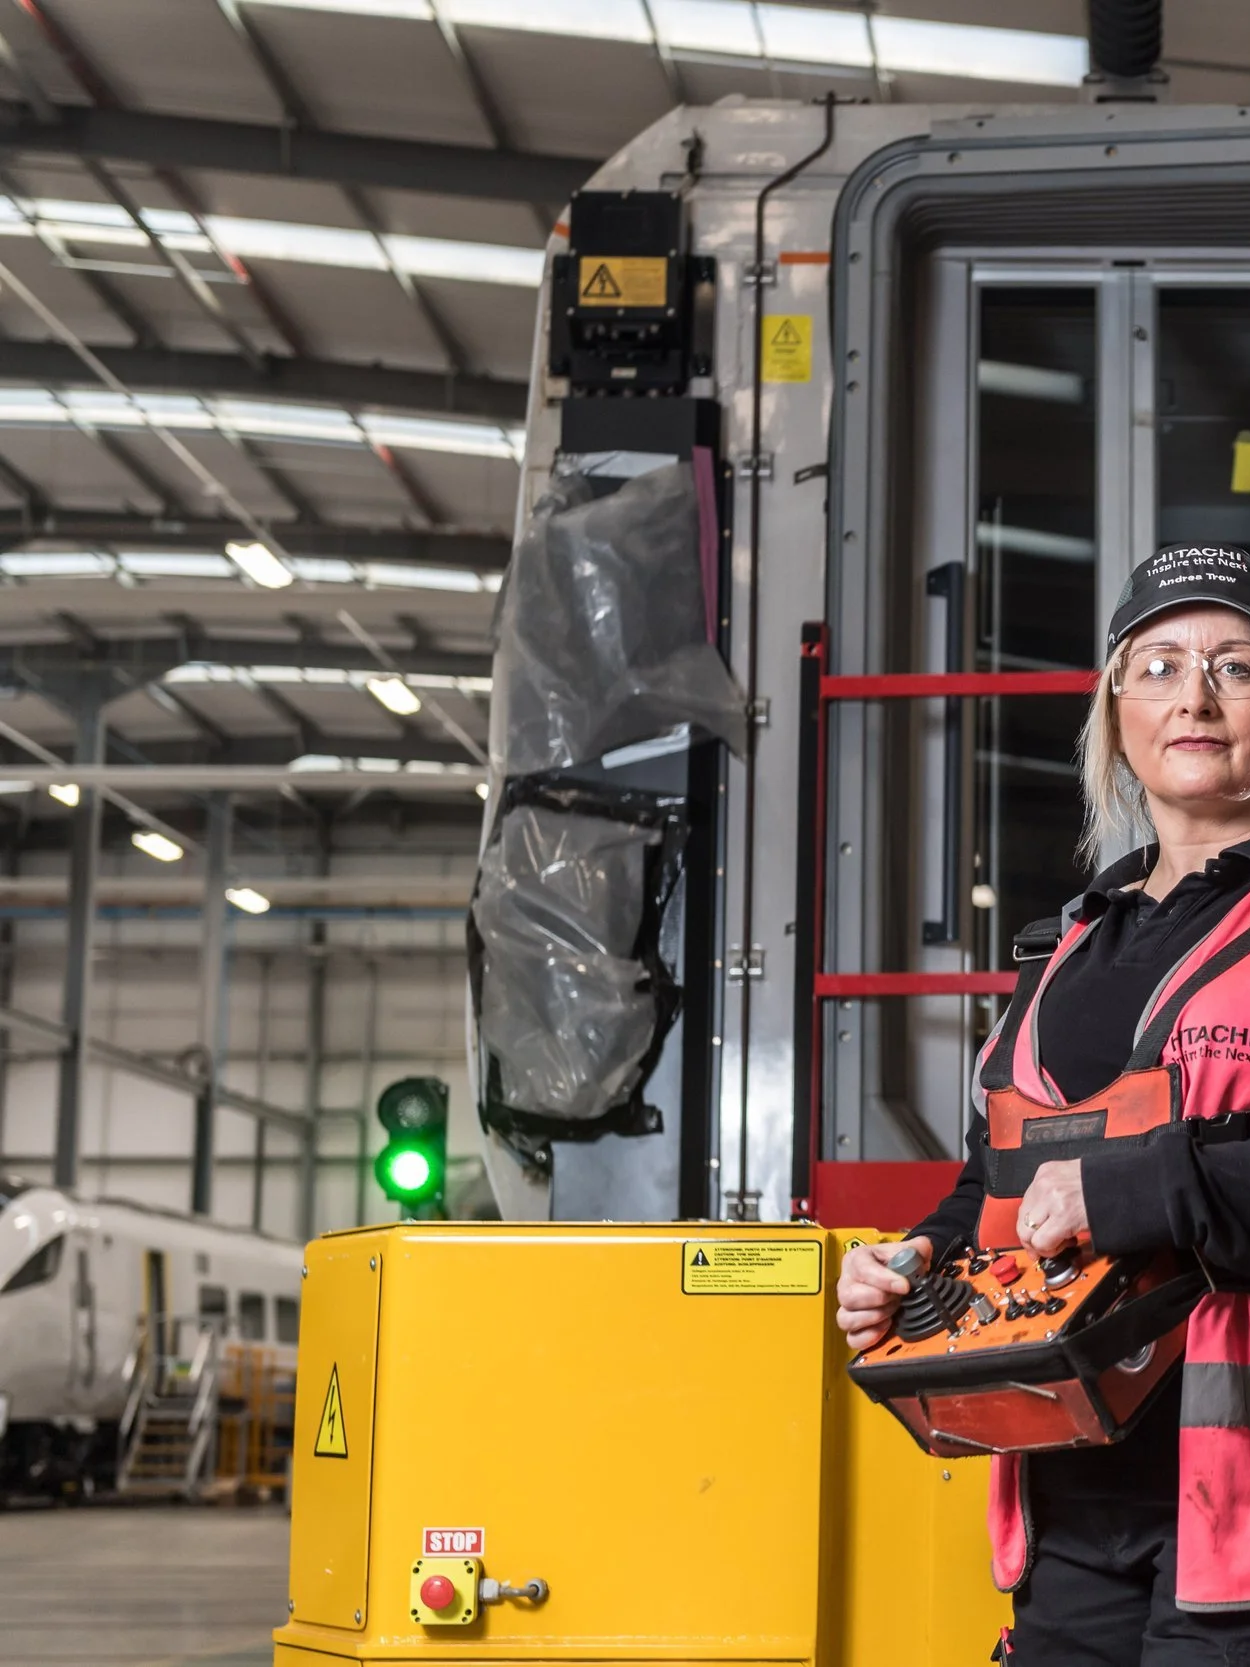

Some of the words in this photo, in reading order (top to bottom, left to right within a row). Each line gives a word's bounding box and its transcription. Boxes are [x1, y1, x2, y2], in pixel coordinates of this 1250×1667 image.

[1146, 558, 1190, 577] Inspire
[1193, 557, 1215, 566] the
[1217, 557, 1248, 573] Next
[1153, 547, 1242, 567] HITACHI
[1158, 572, 1203, 588] Andrea
[1205, 572, 1237, 584] Trow
[430, 1531, 477, 1552] STOP
